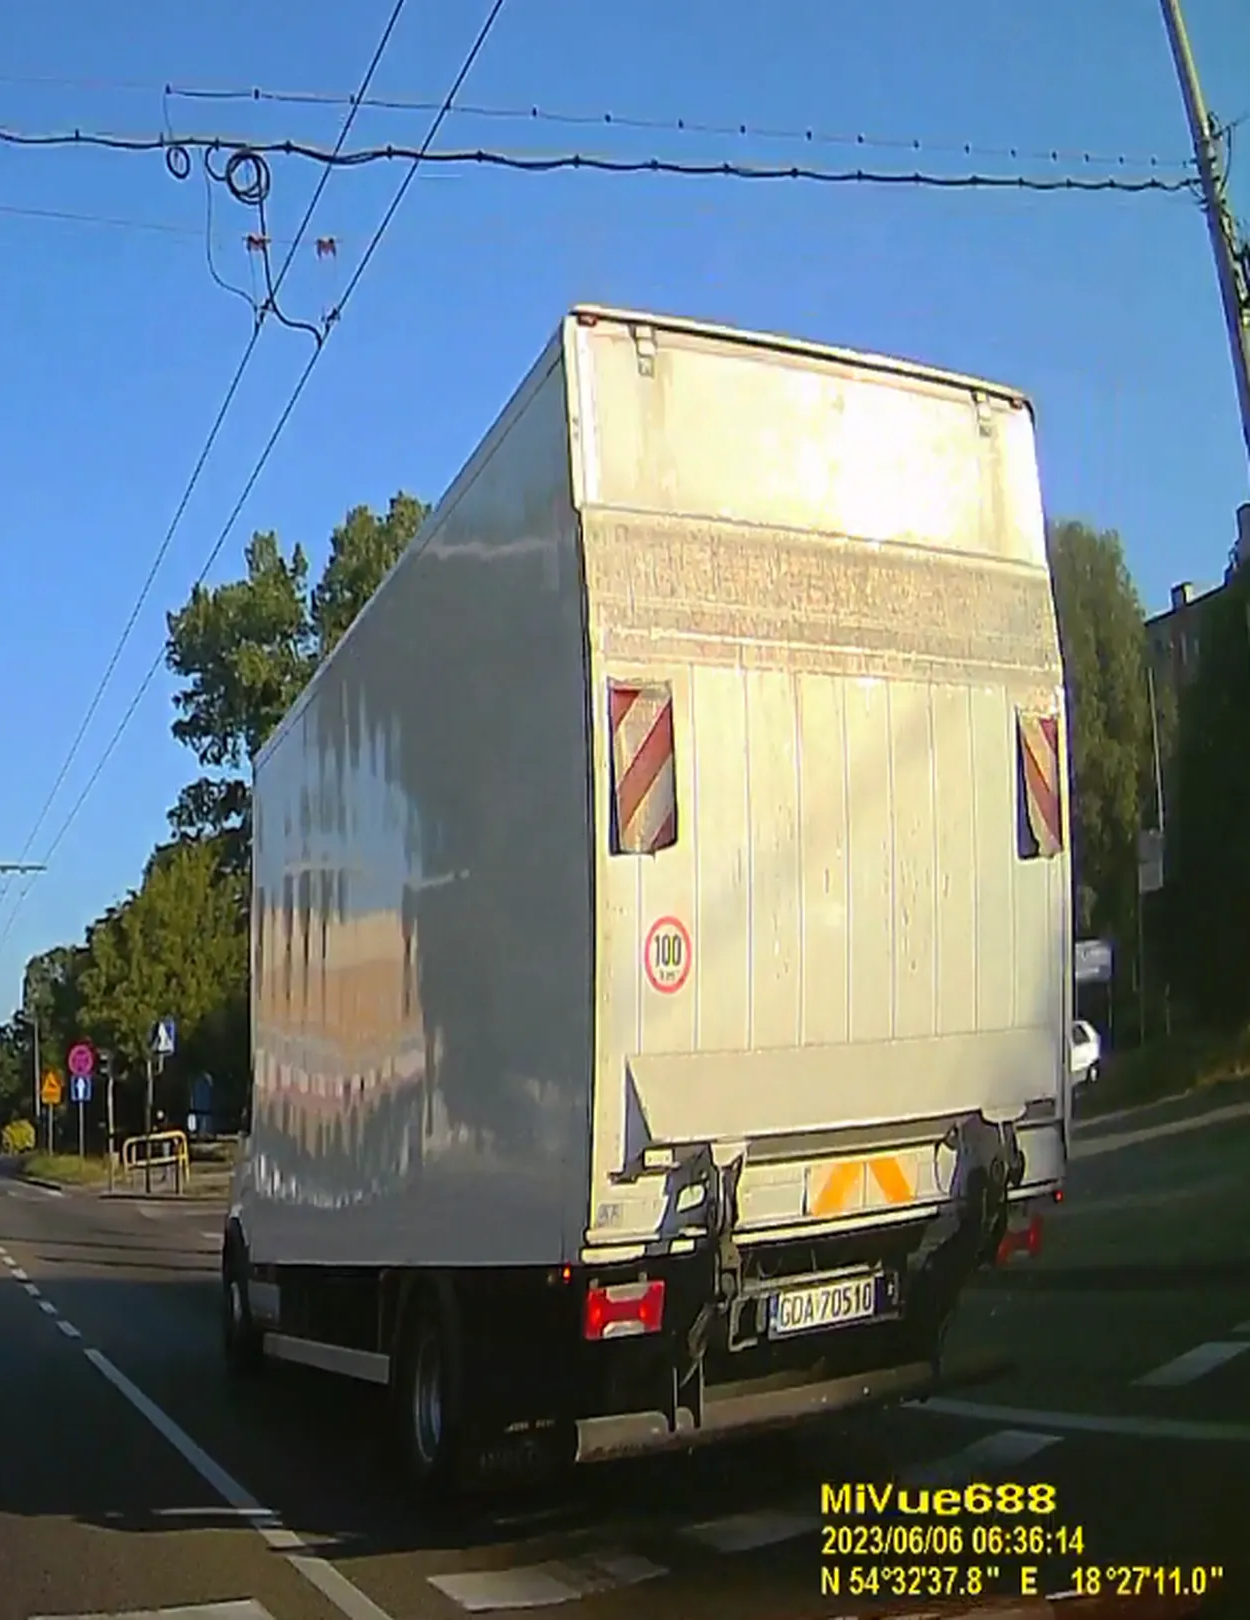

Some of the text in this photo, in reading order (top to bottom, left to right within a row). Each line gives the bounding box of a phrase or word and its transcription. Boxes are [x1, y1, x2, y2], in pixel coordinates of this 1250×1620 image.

[655, 934, 682, 967] 100
[781, 1283, 873, 1327] GDA 70510
